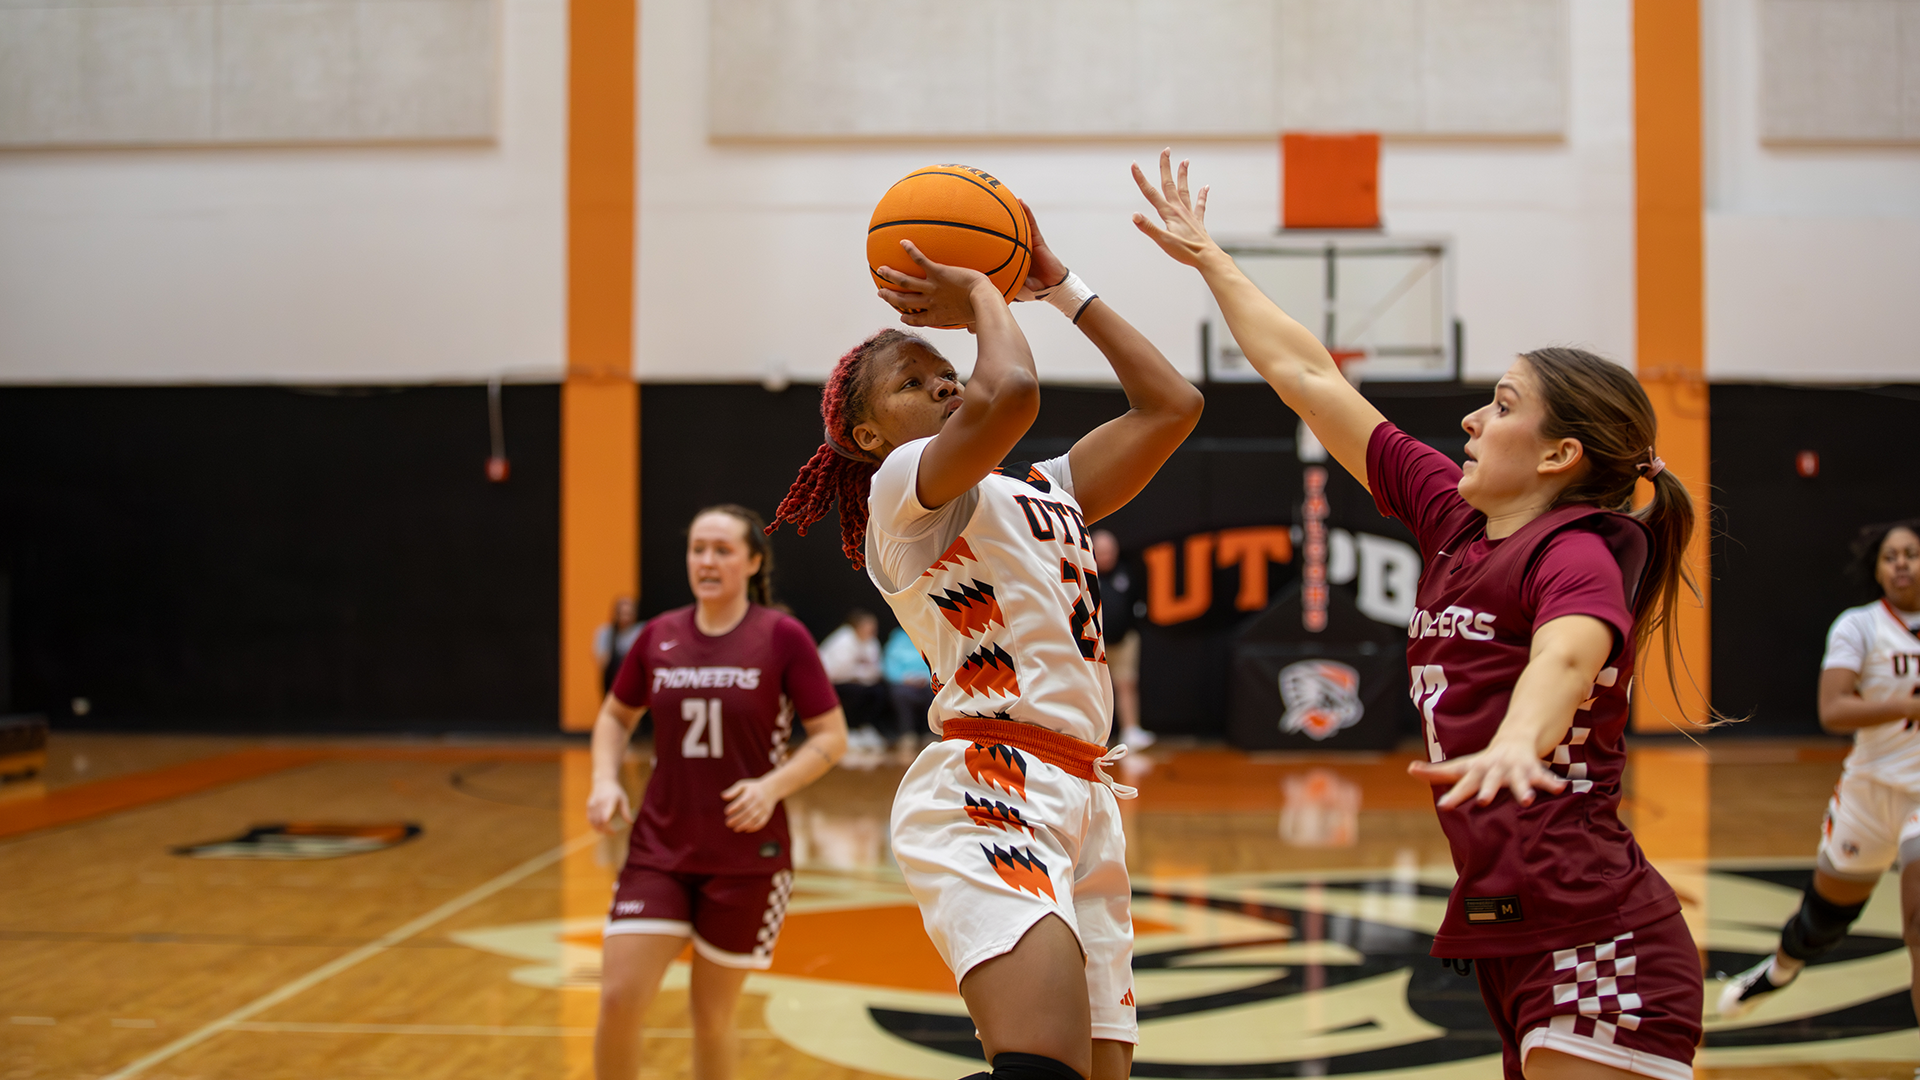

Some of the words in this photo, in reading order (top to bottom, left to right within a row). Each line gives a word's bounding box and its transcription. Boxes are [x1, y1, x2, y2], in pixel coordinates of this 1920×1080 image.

[1012, 494, 1097, 561] UTP
[653, 667, 761, 693] PIONEERS
[682, 698, 723, 758] 21
[1502, 904, 1513, 914] M
